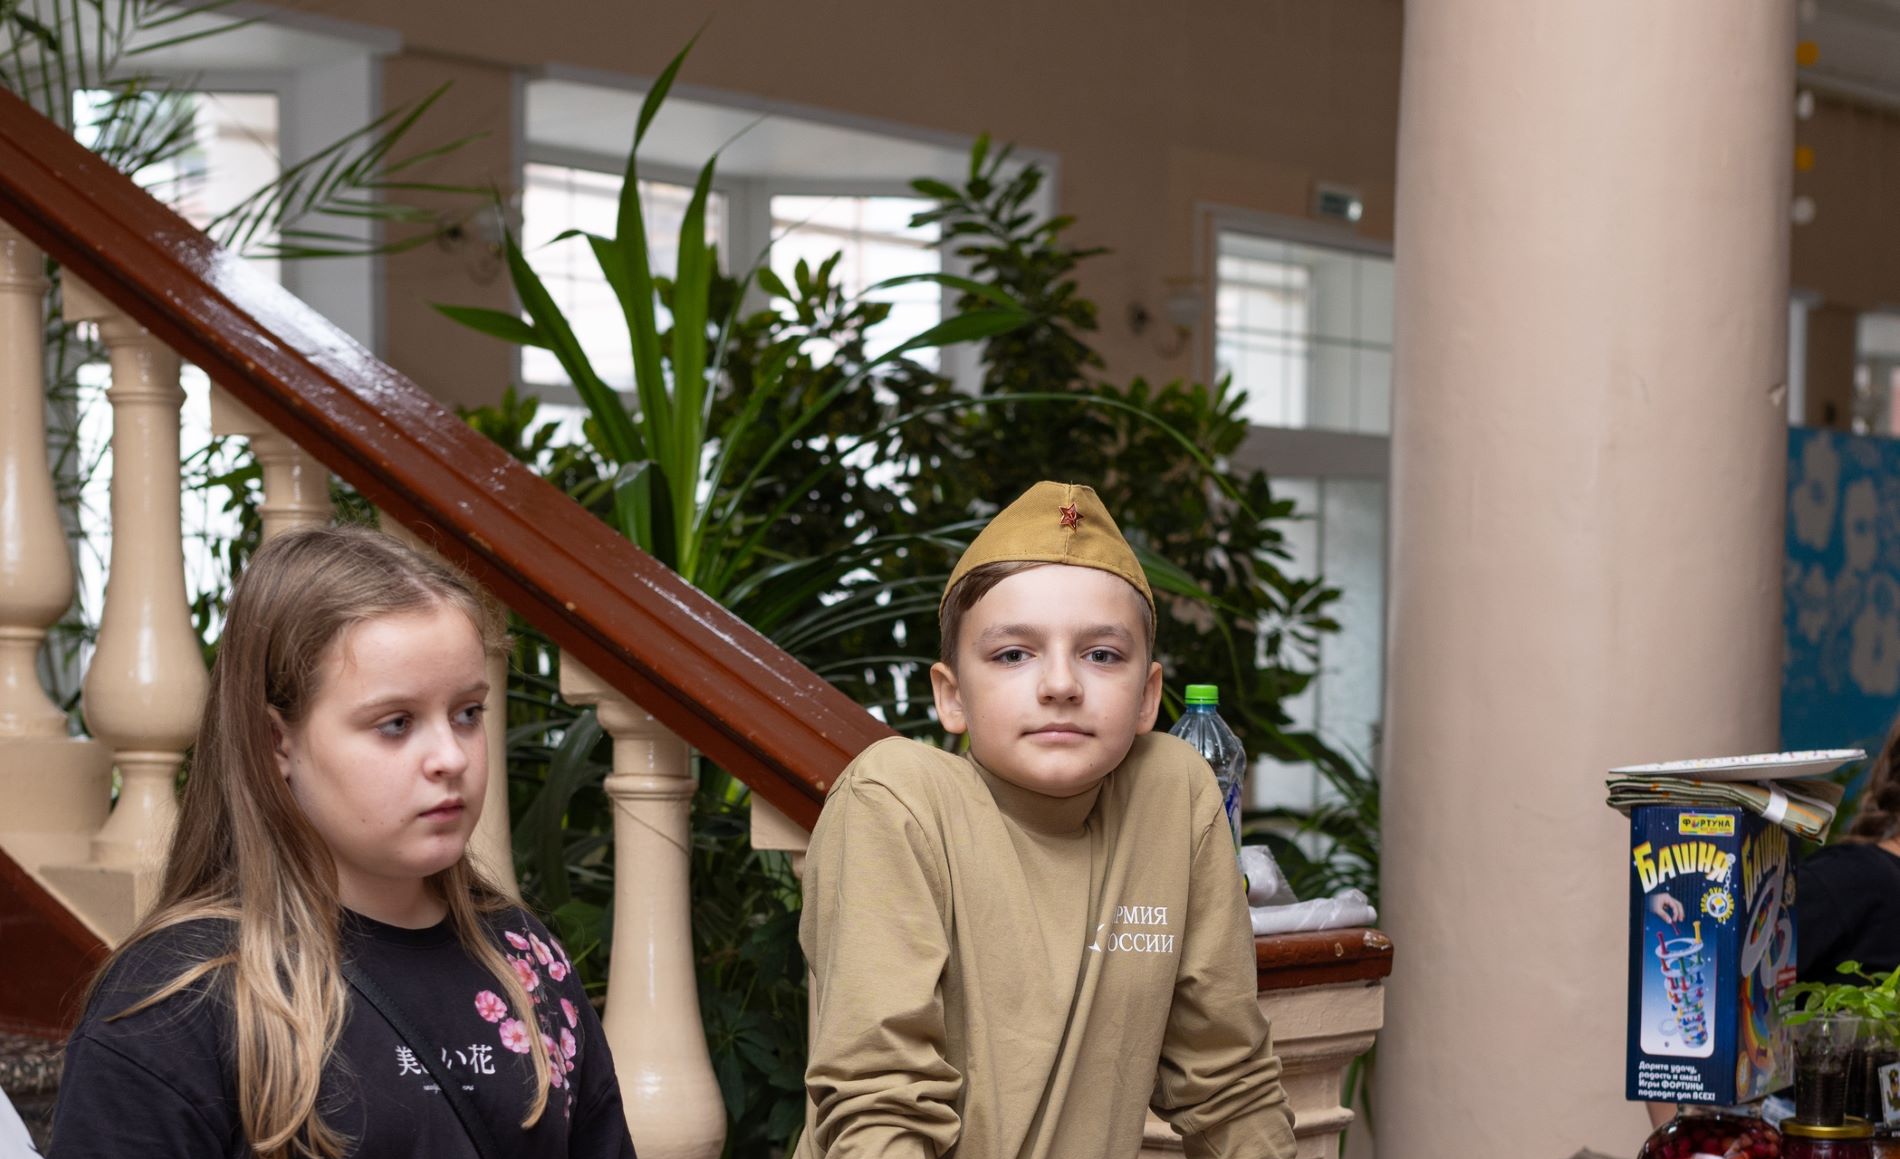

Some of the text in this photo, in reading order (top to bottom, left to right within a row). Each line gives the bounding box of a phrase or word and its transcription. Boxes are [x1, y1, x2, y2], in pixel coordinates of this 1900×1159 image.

[1633, 841, 1728, 894] БАШНЯ
[1113, 906, 1168, 925] РМИЯ
[1107, 932, 1175, 953] ОССИИ
[395, 1044, 496, 1076] 美い花
